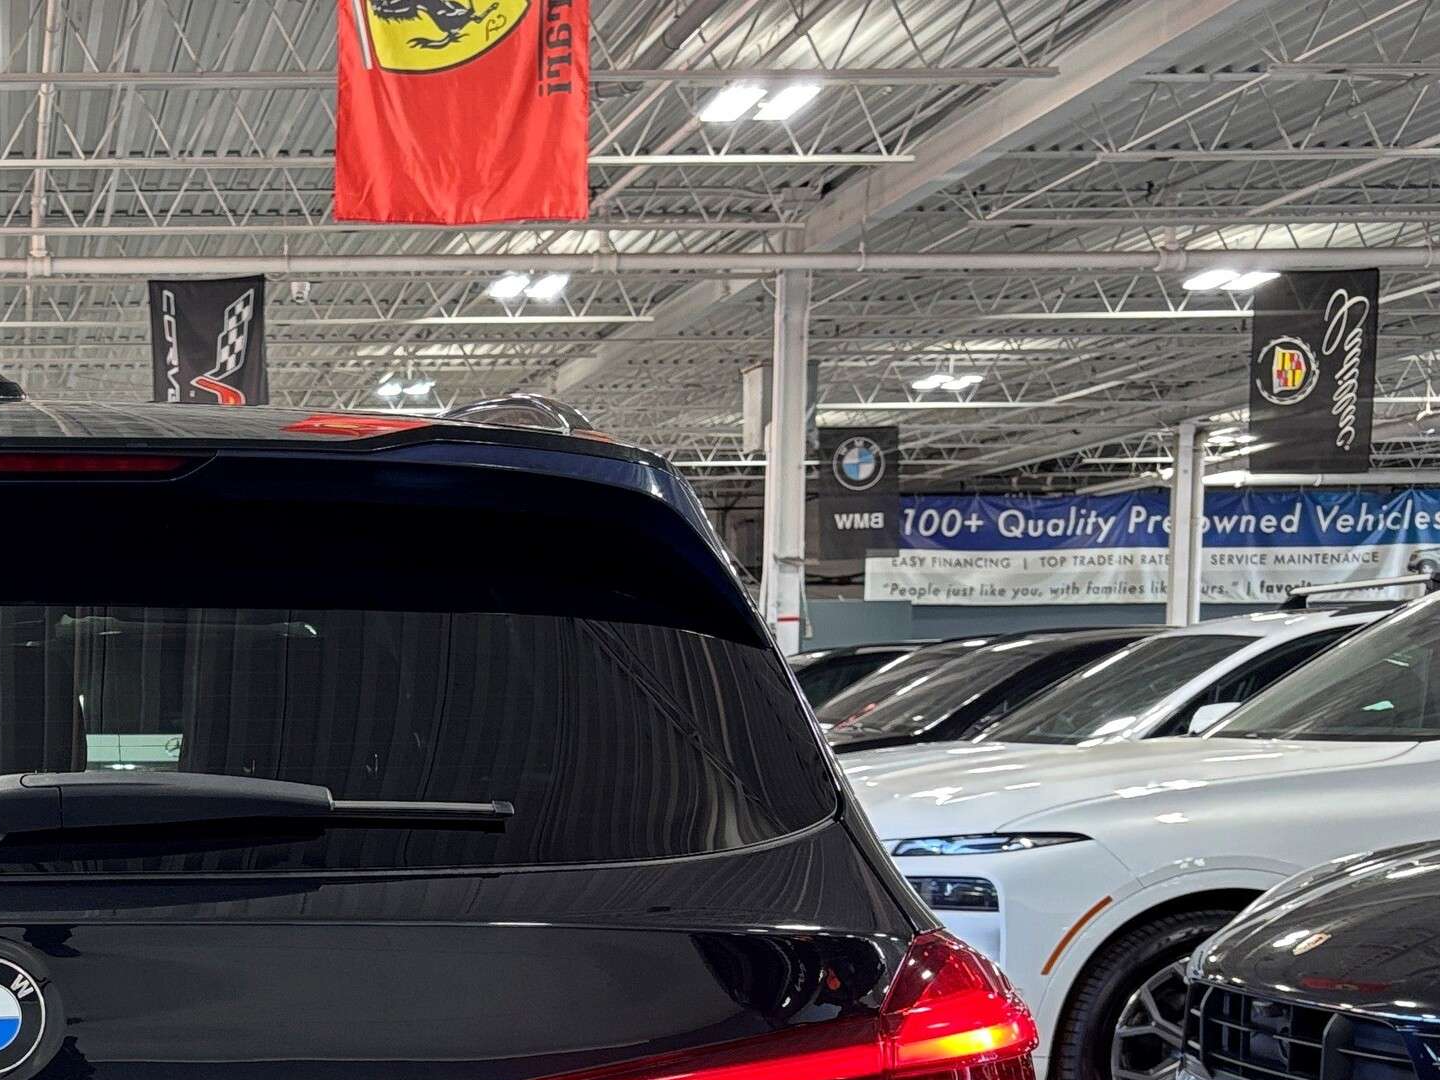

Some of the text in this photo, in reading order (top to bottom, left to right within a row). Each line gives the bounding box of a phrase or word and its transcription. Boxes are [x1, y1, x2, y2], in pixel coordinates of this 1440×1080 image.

[903, 508, 984, 538] 100+
[998, 505, 1116, 544] Quality
[931, 556, 1011, 569] FINANCING
[1040, 556, 1066, 568] TOP
[1140, 554, 1170, 566] RATE
[1210, 553, 1267, 566] SERVICE
[1273, 551, 1379, 565] MAINTENANCE
[946, 583, 975, 599] just
[980, 583, 1007, 597] like
[1049, 581, 1080, 595] with
[1086, 579, 1144, 595] families
[1151, 580, 1168, 595] lik
